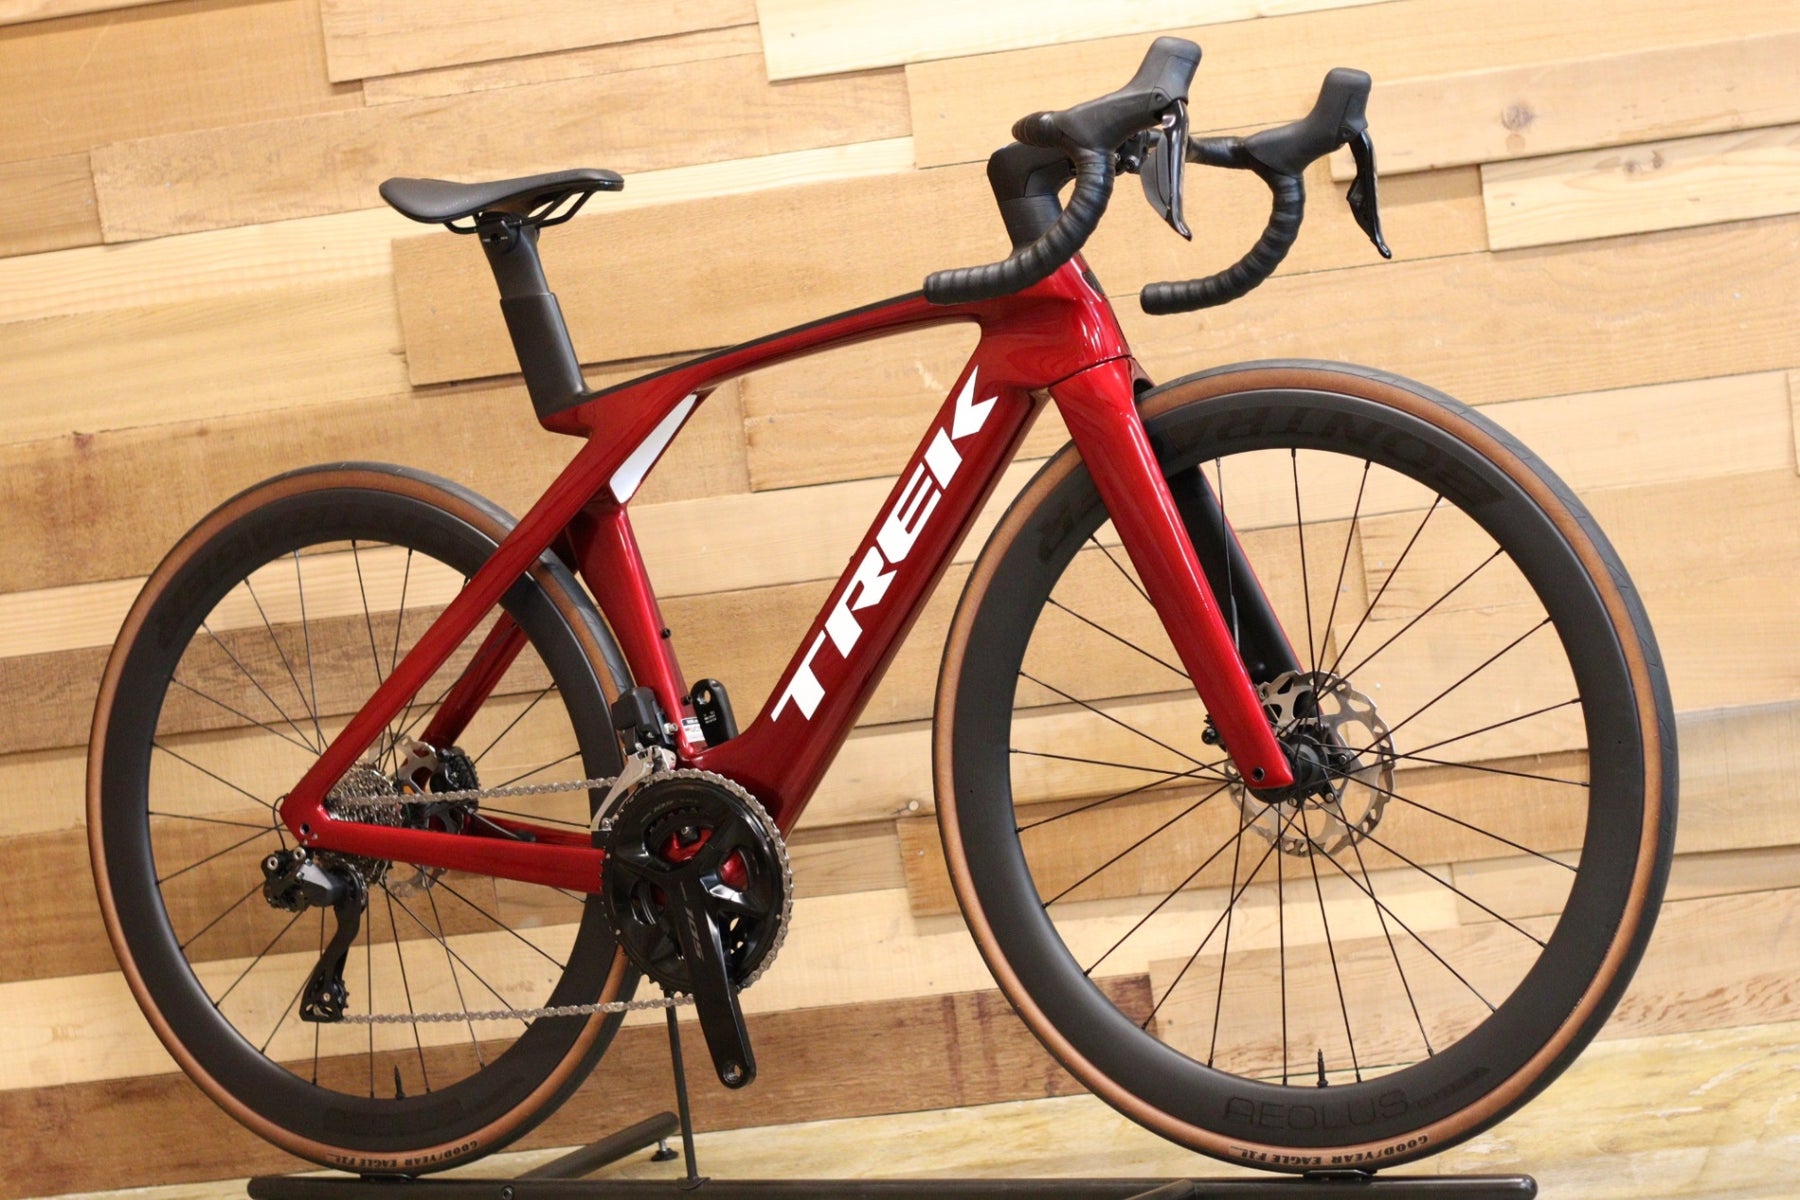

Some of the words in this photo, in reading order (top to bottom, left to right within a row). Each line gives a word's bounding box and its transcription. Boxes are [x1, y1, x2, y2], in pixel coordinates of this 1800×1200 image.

[770, 365, 999, 722] TREK
[1222, 1089, 1409, 1130] AEOLUS
[361, 1158, 397, 1168] EAGLE
[1272, 1154, 1321, 1165] EAGLE
